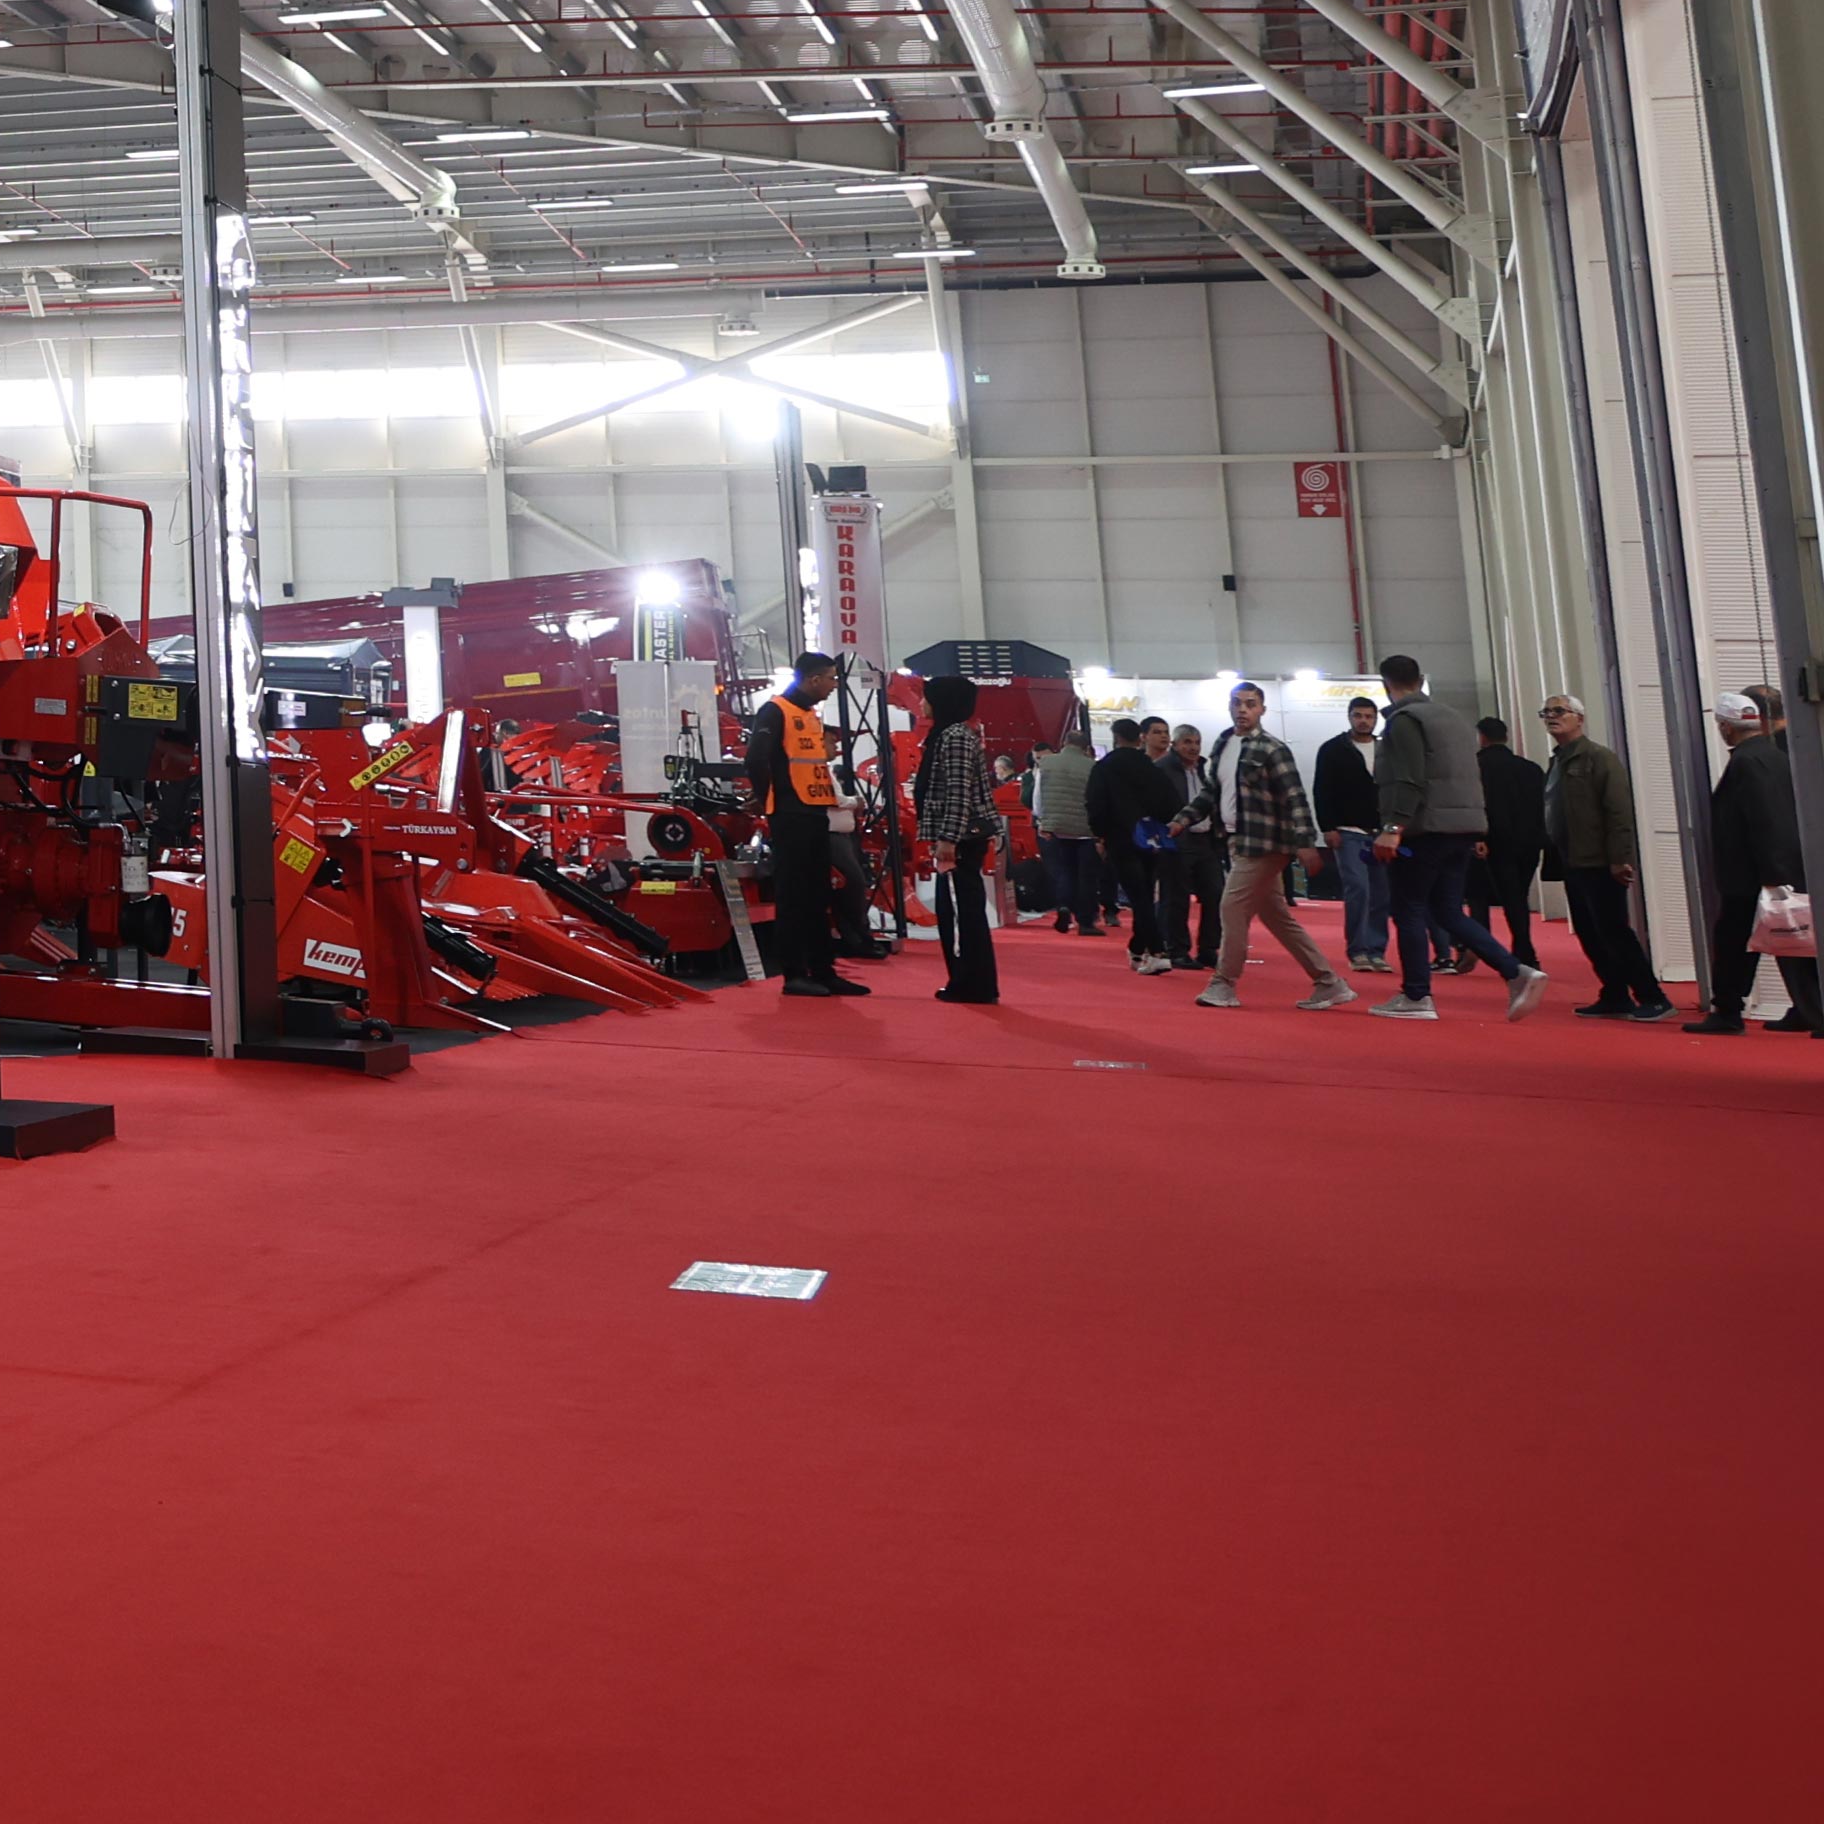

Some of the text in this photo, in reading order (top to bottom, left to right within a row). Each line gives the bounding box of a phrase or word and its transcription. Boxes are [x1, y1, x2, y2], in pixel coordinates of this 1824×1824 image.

[836, 525, 857, 644] KARAOVA
[654, 610, 667, 661] ASTER
[171, 907, 188, 937] 5
[308, 941, 364, 976] kemp
